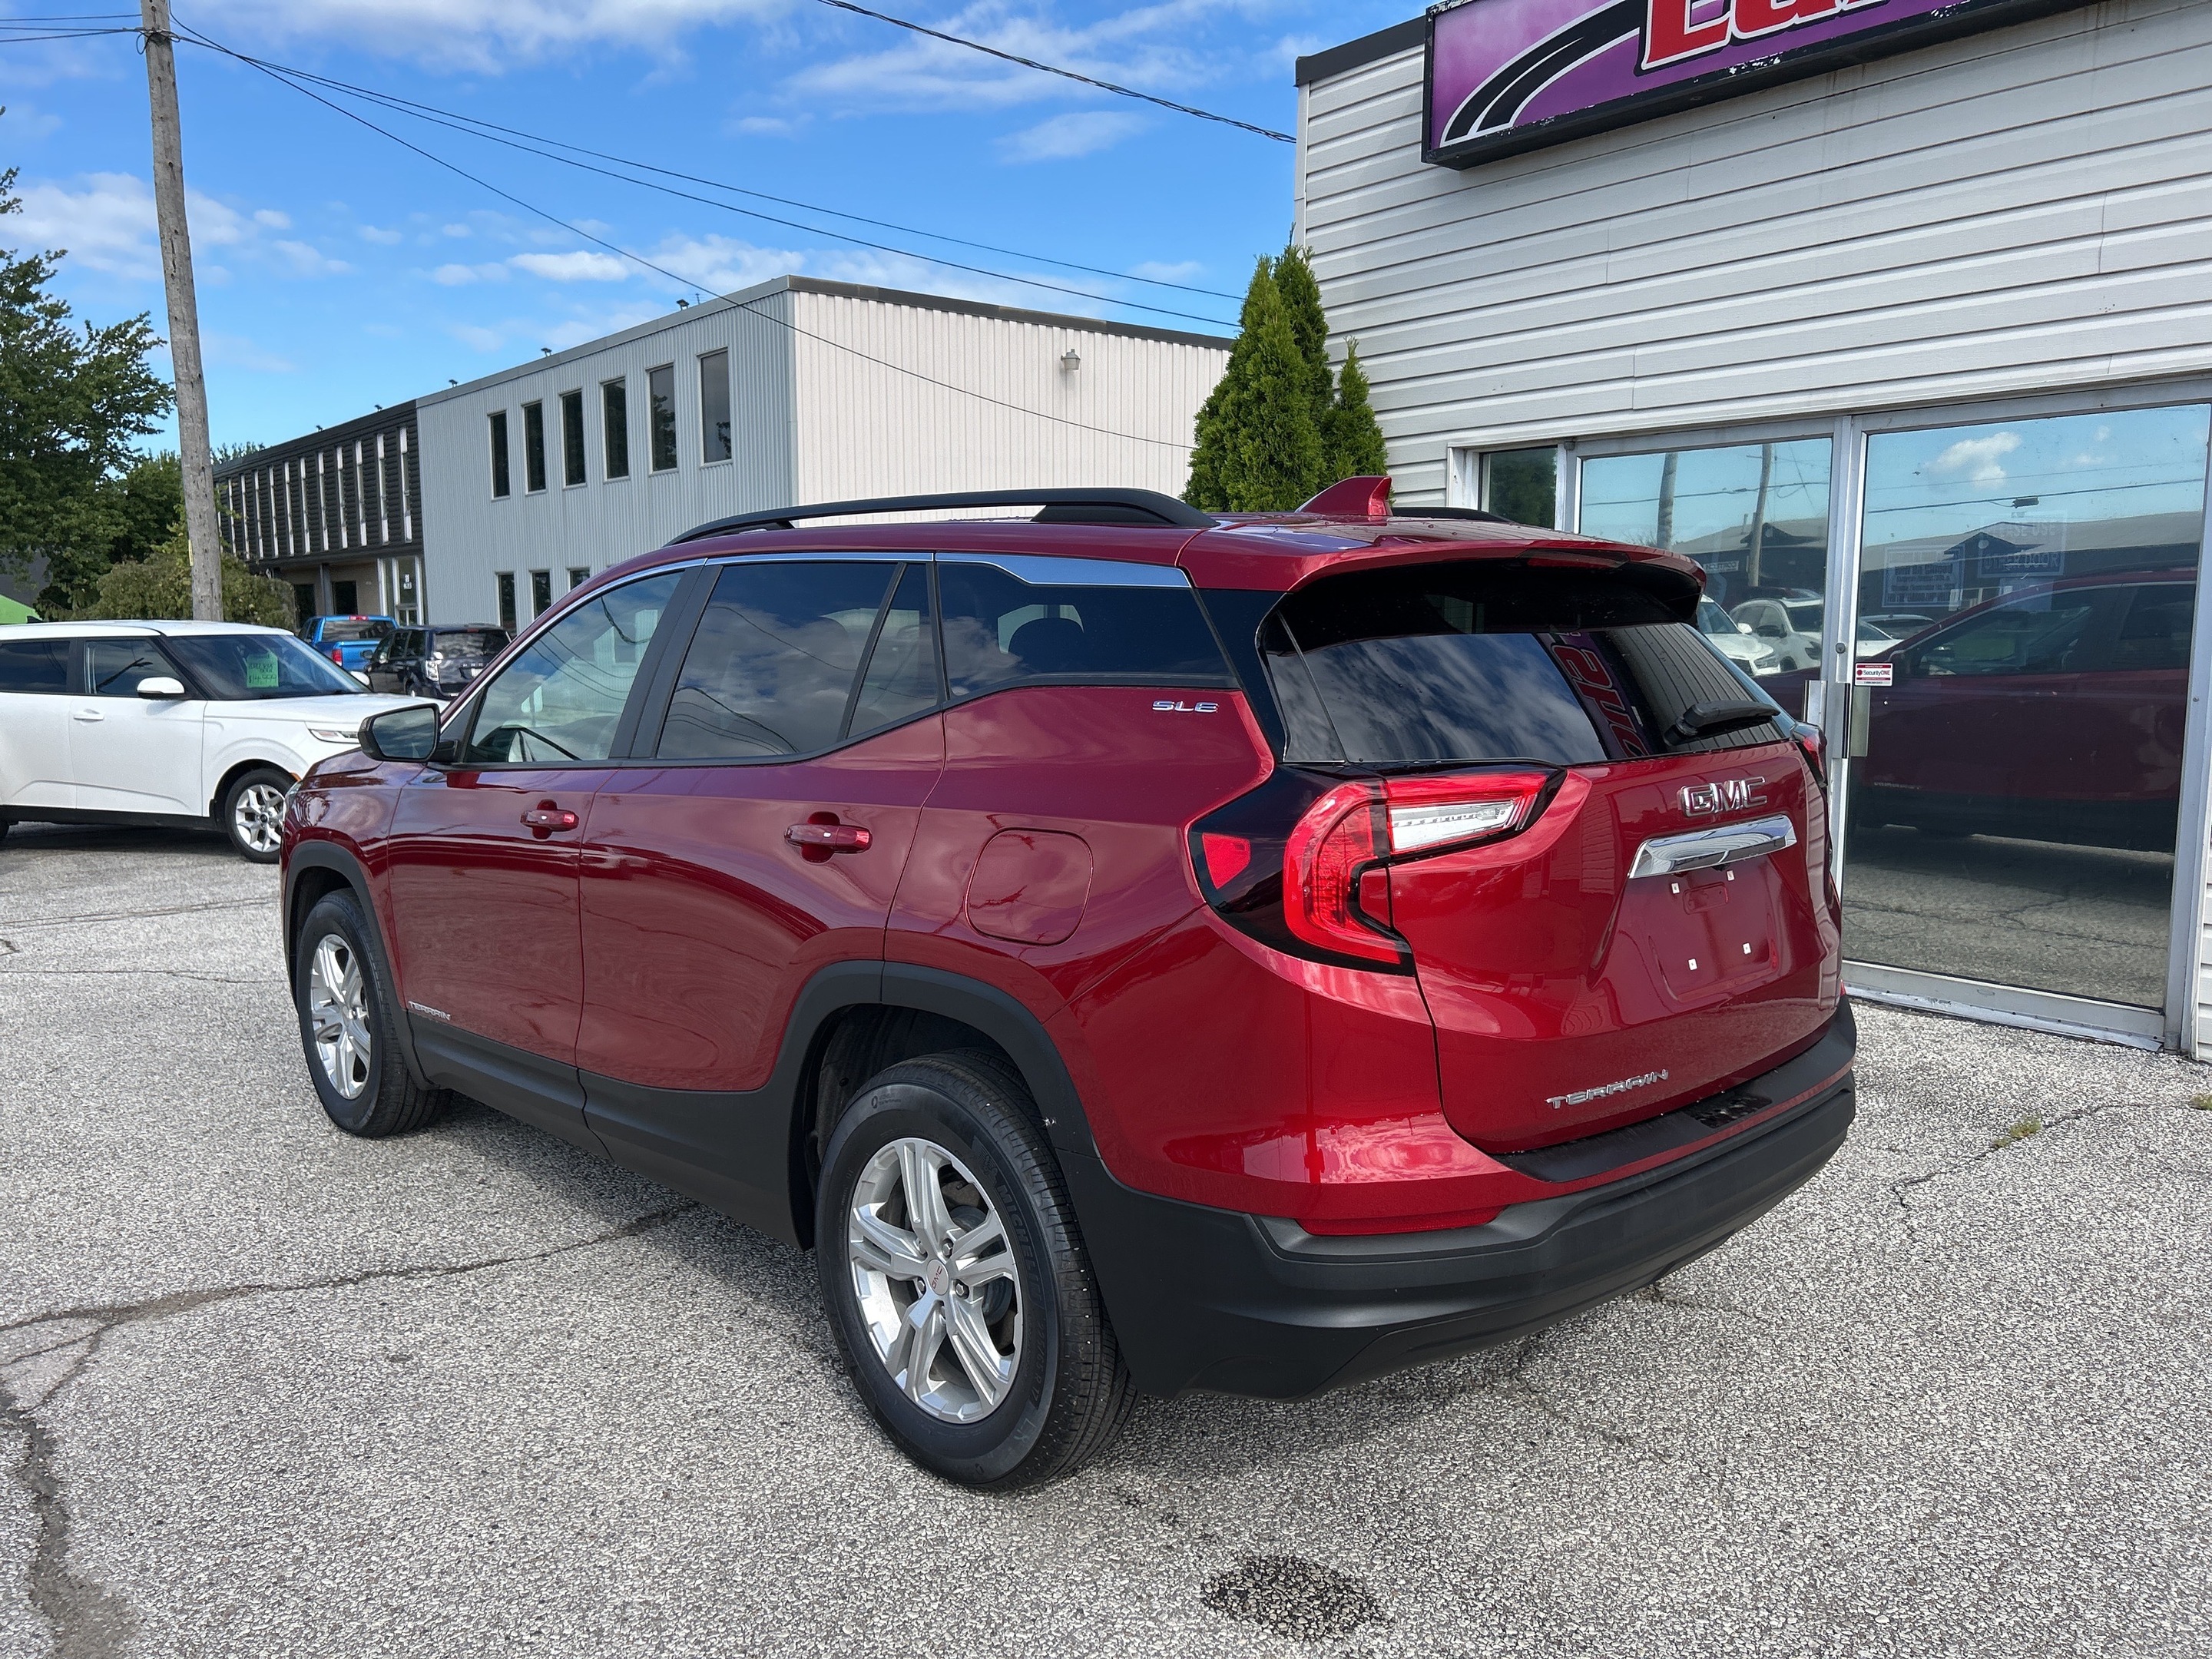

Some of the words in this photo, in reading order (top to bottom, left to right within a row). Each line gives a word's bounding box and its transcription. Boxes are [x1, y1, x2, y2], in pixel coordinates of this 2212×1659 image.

[1152, 700, 1219, 713] SLE
[1681, 776, 1768, 817] GMC
[408, 1000, 451, 1022] TERRAIN
[1545, 1068, 1669, 1110] TERRAIN
[998, 1184, 1043, 1302] MICHELIN
[932, 1266, 943, 1290] GMC
